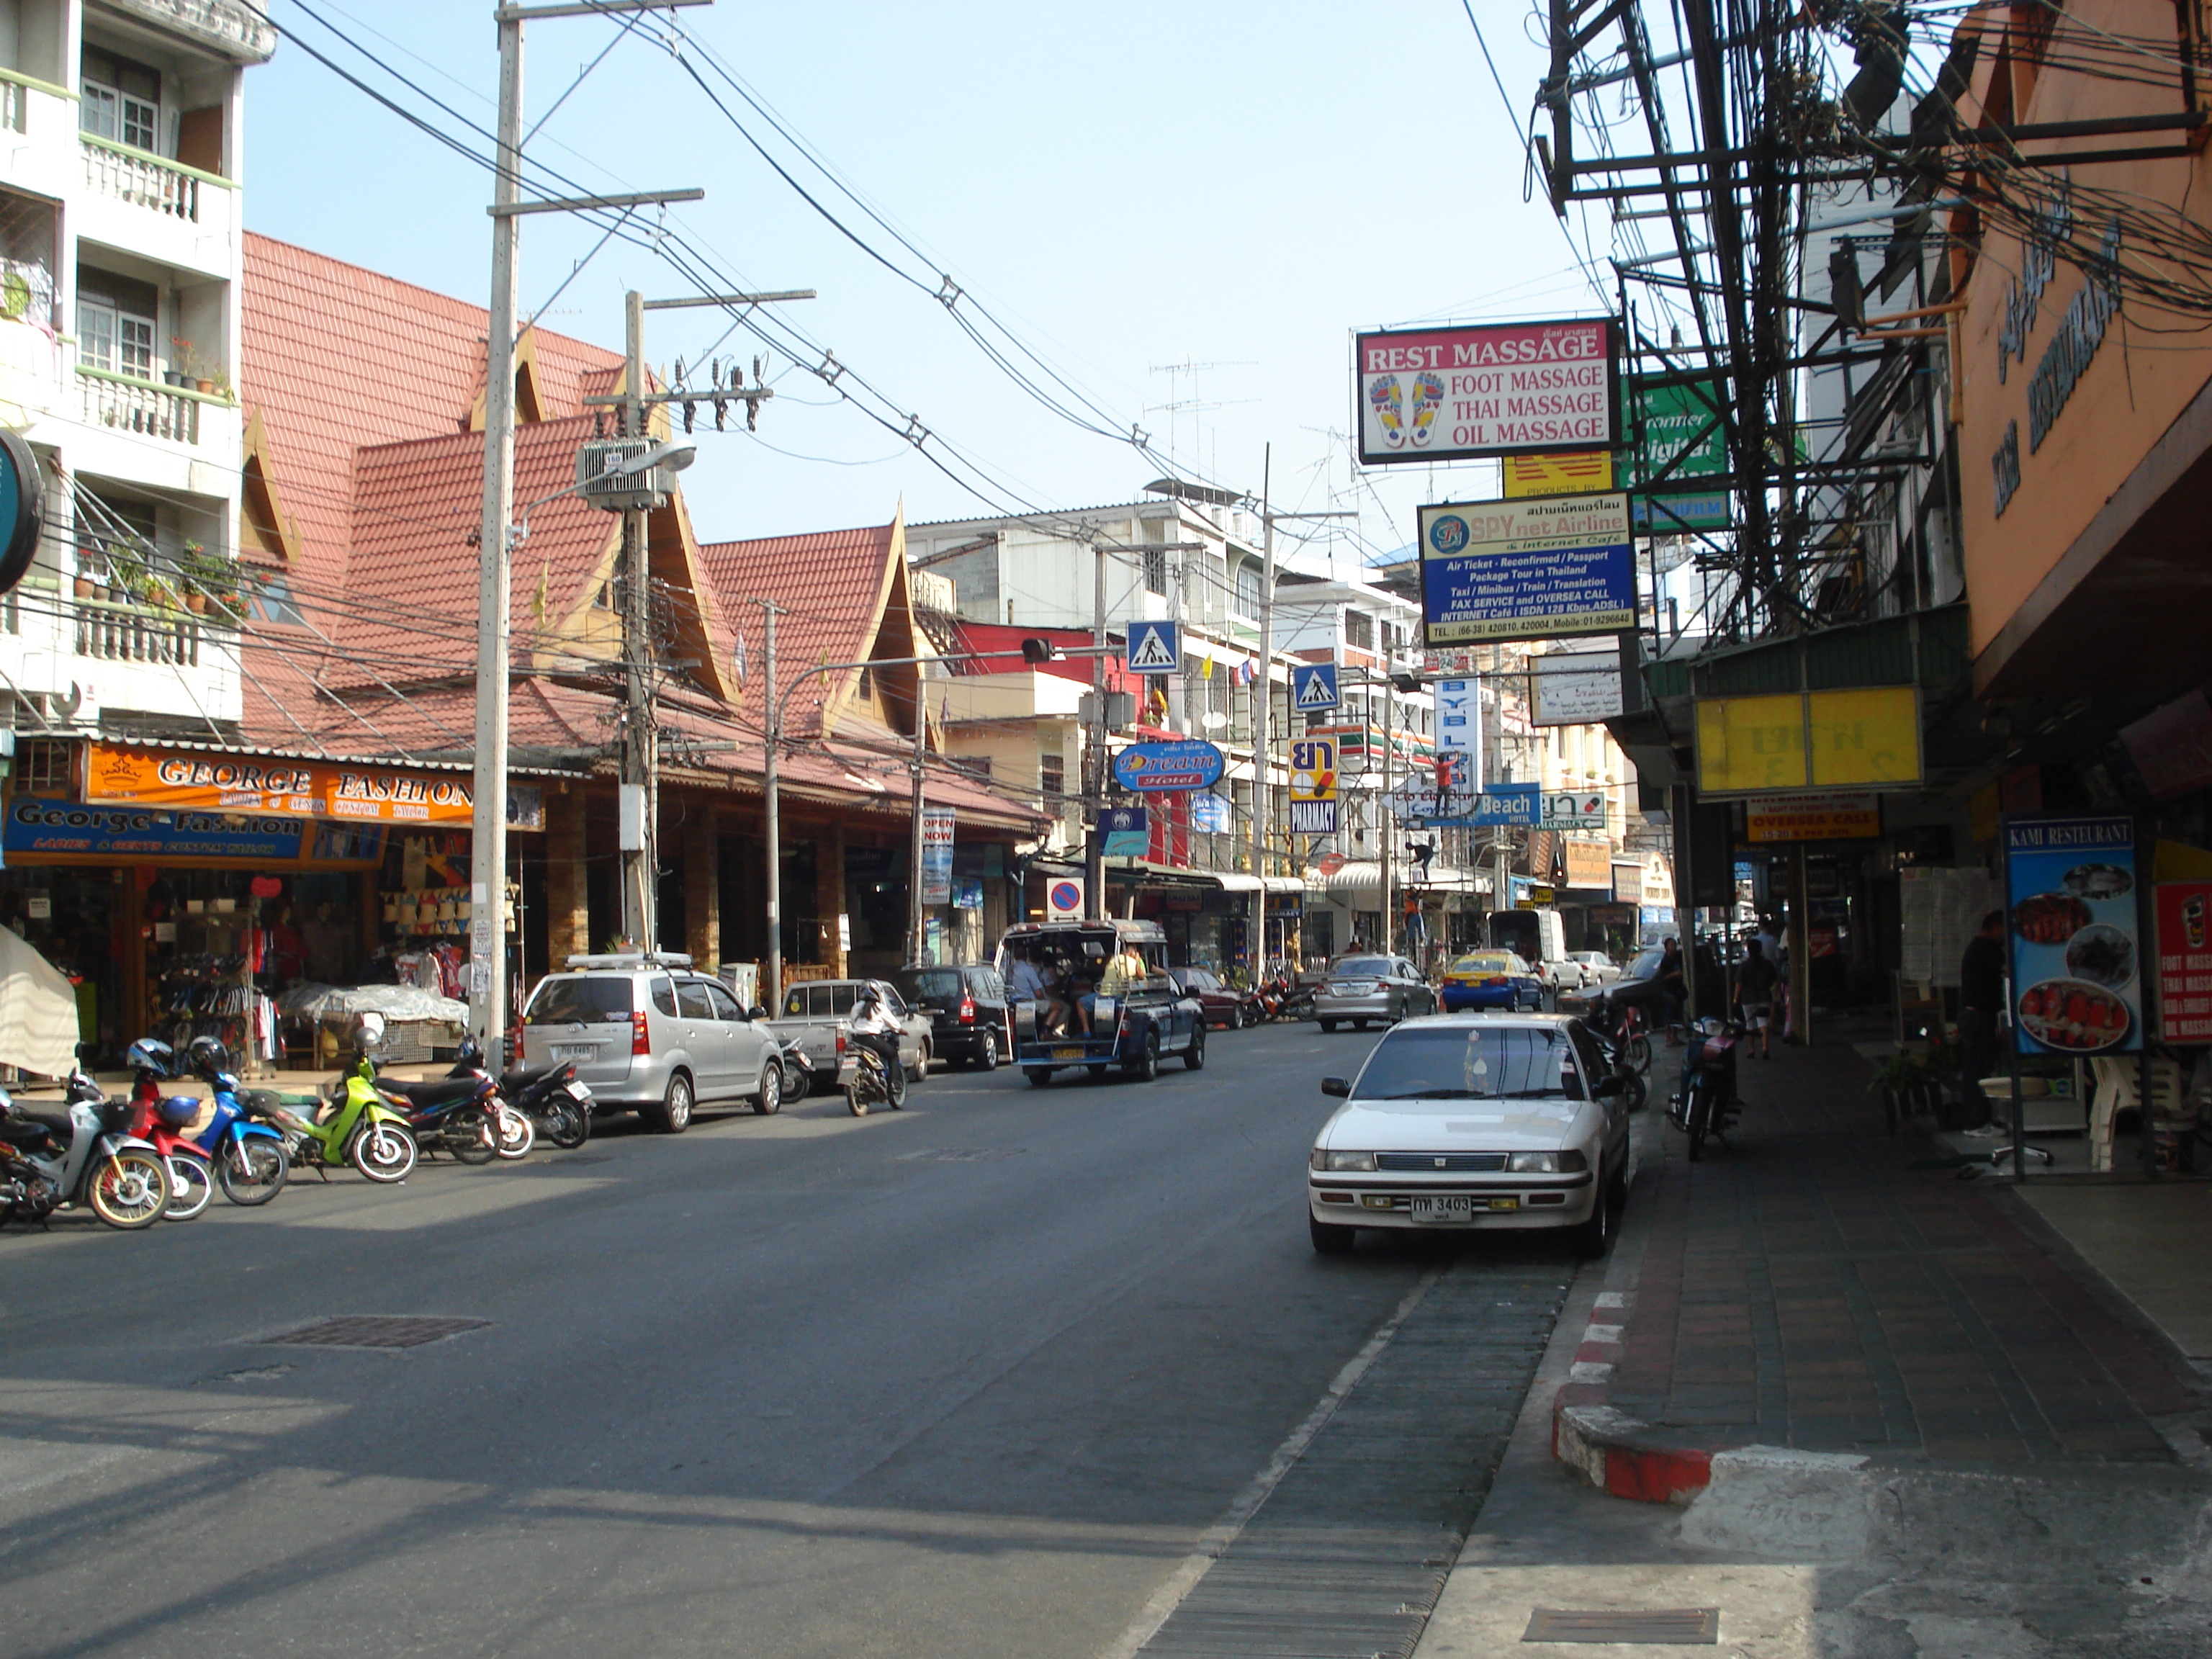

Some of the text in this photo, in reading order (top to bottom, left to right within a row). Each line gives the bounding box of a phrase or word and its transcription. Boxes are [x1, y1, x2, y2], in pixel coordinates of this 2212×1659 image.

[1368, 336, 1599, 371] REST MASSAGE
[1451, 366, 1604, 395] FOOT MASSAGE
[1453, 398, 1501, 421] THAI
[1507, 392, 1604, 417] MASSAGE
[1452, 418, 1604, 446] OIL MASSAGE
[1527, 483, 1596, 495] PRODUCTS BY
[1556, 515, 1623, 534] Airline
[1447, 561, 1462, 572] Air
[1464, 558, 1493, 570] Ticket
[1501, 552, 1560, 567] Reconfirmed
[1567, 551, 1609, 563] Passport
[1470, 565, 1588, 583] Package Tour in Thailand
[1451, 586, 1470, 597] Taxi
[1478, 583, 1514, 595] Minibus
[1522, 581, 1546, 592] Train
[1554, 577, 1606, 589] Translation
[1451, 589, 1610, 610] FAX SERVICE and OVERSEA CALL
[1441, 610, 1489, 622] INTERNET
[1490, 607, 1512, 619] Café
[1519, 605, 1545, 616] ISDN
[1547, 603, 1564, 613] 128
[1434, 626, 1449, 637] TEL.
[1458, 624, 1485, 636] (66-38)
[1488, 622, 1519, 633] 420810,
[1440, 657, 1453, 669] 24
[1120, 754, 1215, 773] Dream
[1292, 742, 1333, 770] ยา
[158, 757, 473, 808] GEORGE FASHION
[1143, 774, 1197, 785] Hotel
[219, 792, 262, 808] LADIES
[289, 796, 325, 813] GENTS
[334, 801, 380, 817] CUSTOM
[393, 805, 430, 819] TAILOR
[1483, 793, 1531, 814] Beach
[15, 802, 150, 835] George
[924, 819, 953, 828] OPEN
[1292, 802, 1336, 832] PHARMACY
[1536, 821, 1584, 830] PHARMACY
[1752, 812, 1872, 827] OVERSEA CALL
[33, 837, 91, 850] LADIES
[111, 840, 163, 852] GENTS
[924, 832, 952, 841] NOW
[2010, 824, 2131, 848] KAMI RESTEURANT
[2162, 955, 2182, 971] FOOT
[2162, 977, 2183, 993] THAI
[1437, 1197, 1469, 1211] 3403
